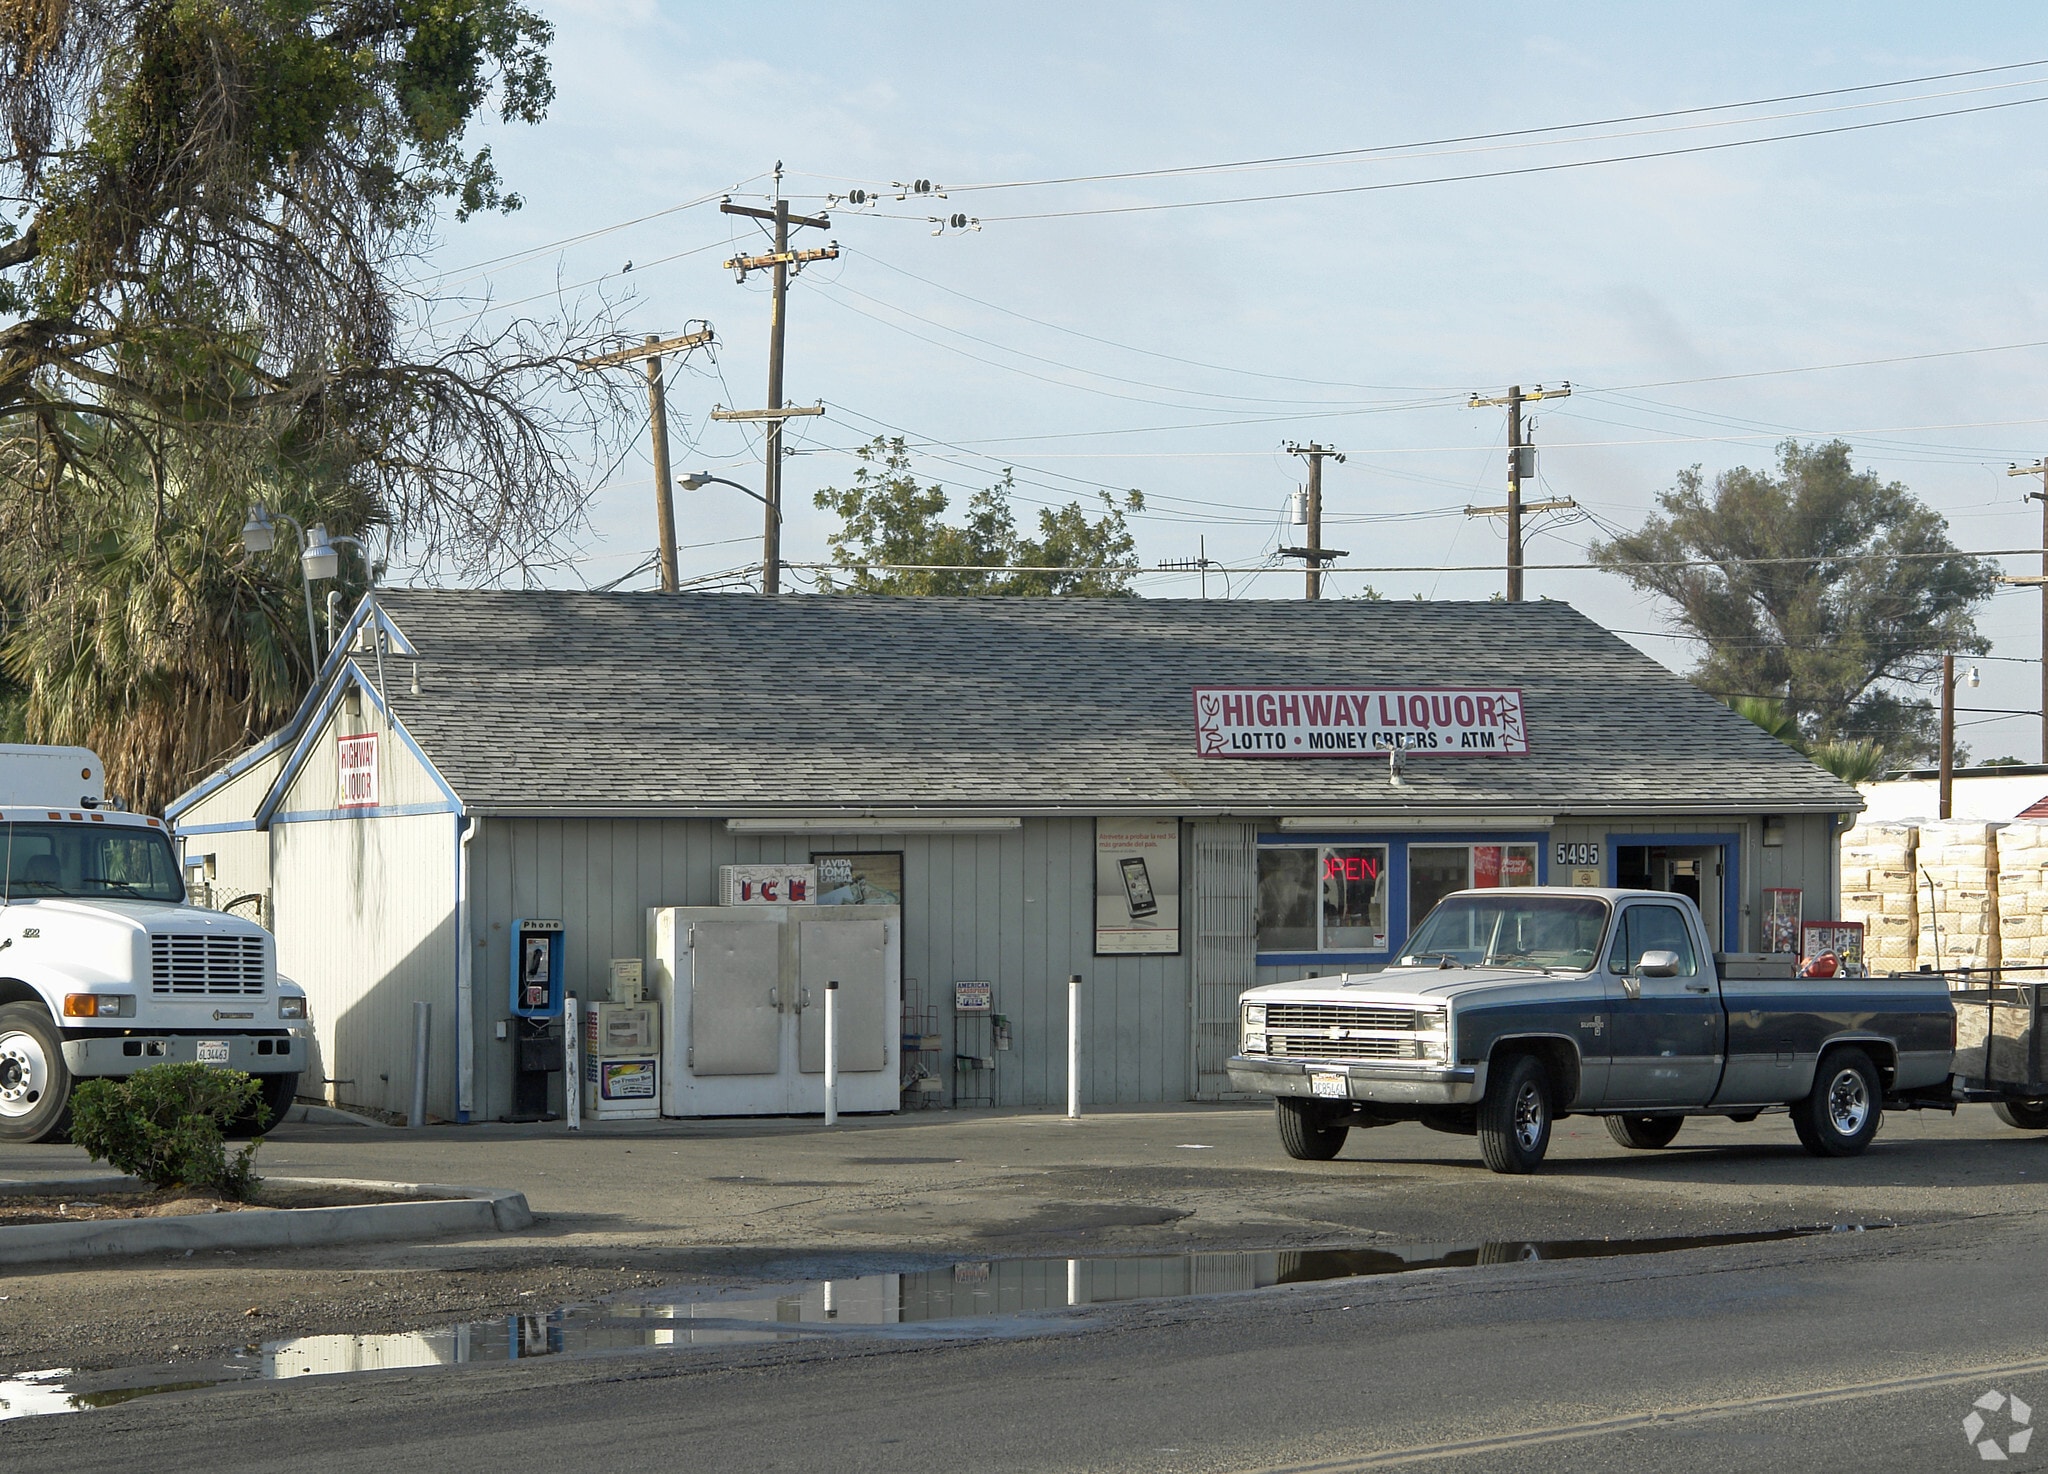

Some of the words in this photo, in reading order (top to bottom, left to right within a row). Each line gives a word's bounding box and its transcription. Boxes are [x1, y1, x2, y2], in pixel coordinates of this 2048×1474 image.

[1222, 694, 1370, 727] HIGHWAY
[1378, 694, 1499, 731] LIQUOR
[1231, 732, 1286, 749] LOTTO
[1308, 732, 1367, 749] MONEY
[1461, 732, 1495, 748] ATM
[341, 741, 373, 768] HIGHWAY
[345, 773, 371, 800] LIQUOR
[821, 859, 831, 867] LA
[831, 859, 852, 867] VIDA
[1502, 859, 1526, 867] Money
[1557, 844, 1598, 864] 5495
[819, 867, 852, 876] TOMA
[741, 876, 806, 901] ICE
